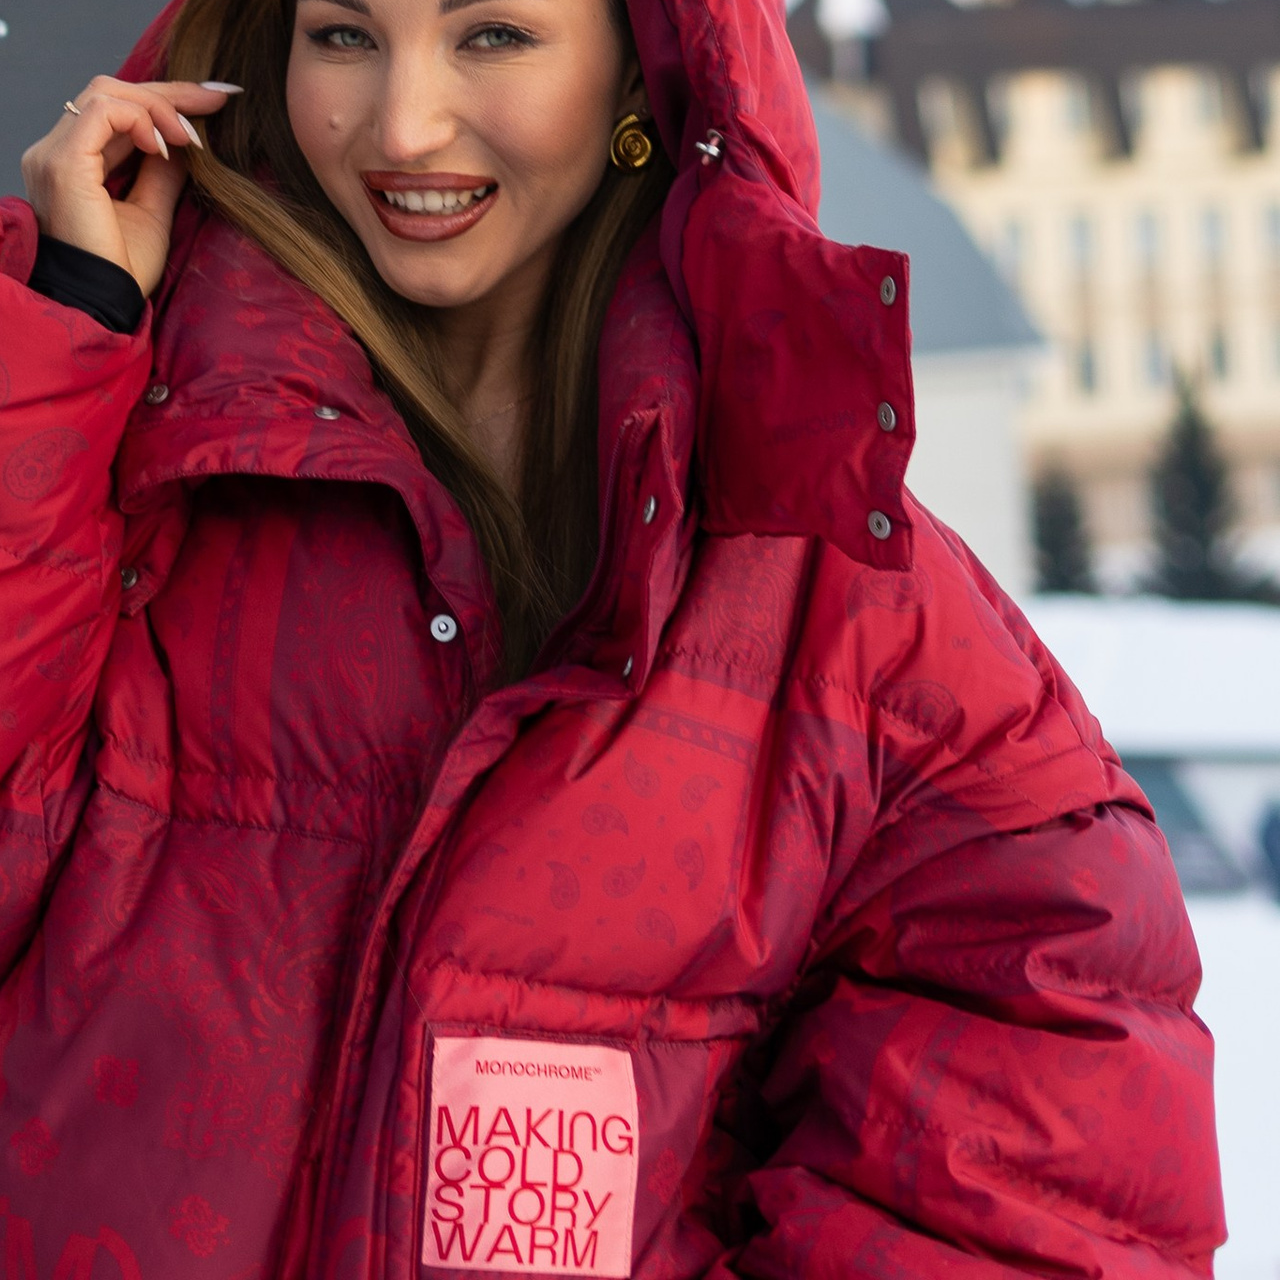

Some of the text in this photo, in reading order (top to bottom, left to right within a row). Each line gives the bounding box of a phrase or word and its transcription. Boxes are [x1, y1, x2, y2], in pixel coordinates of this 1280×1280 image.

[436, 1106, 634, 1156] MAKING
[434, 1145, 584, 1190] COLD
[431, 1183, 614, 1230] STORY
[431, 1220, 599, 1270] WARM
